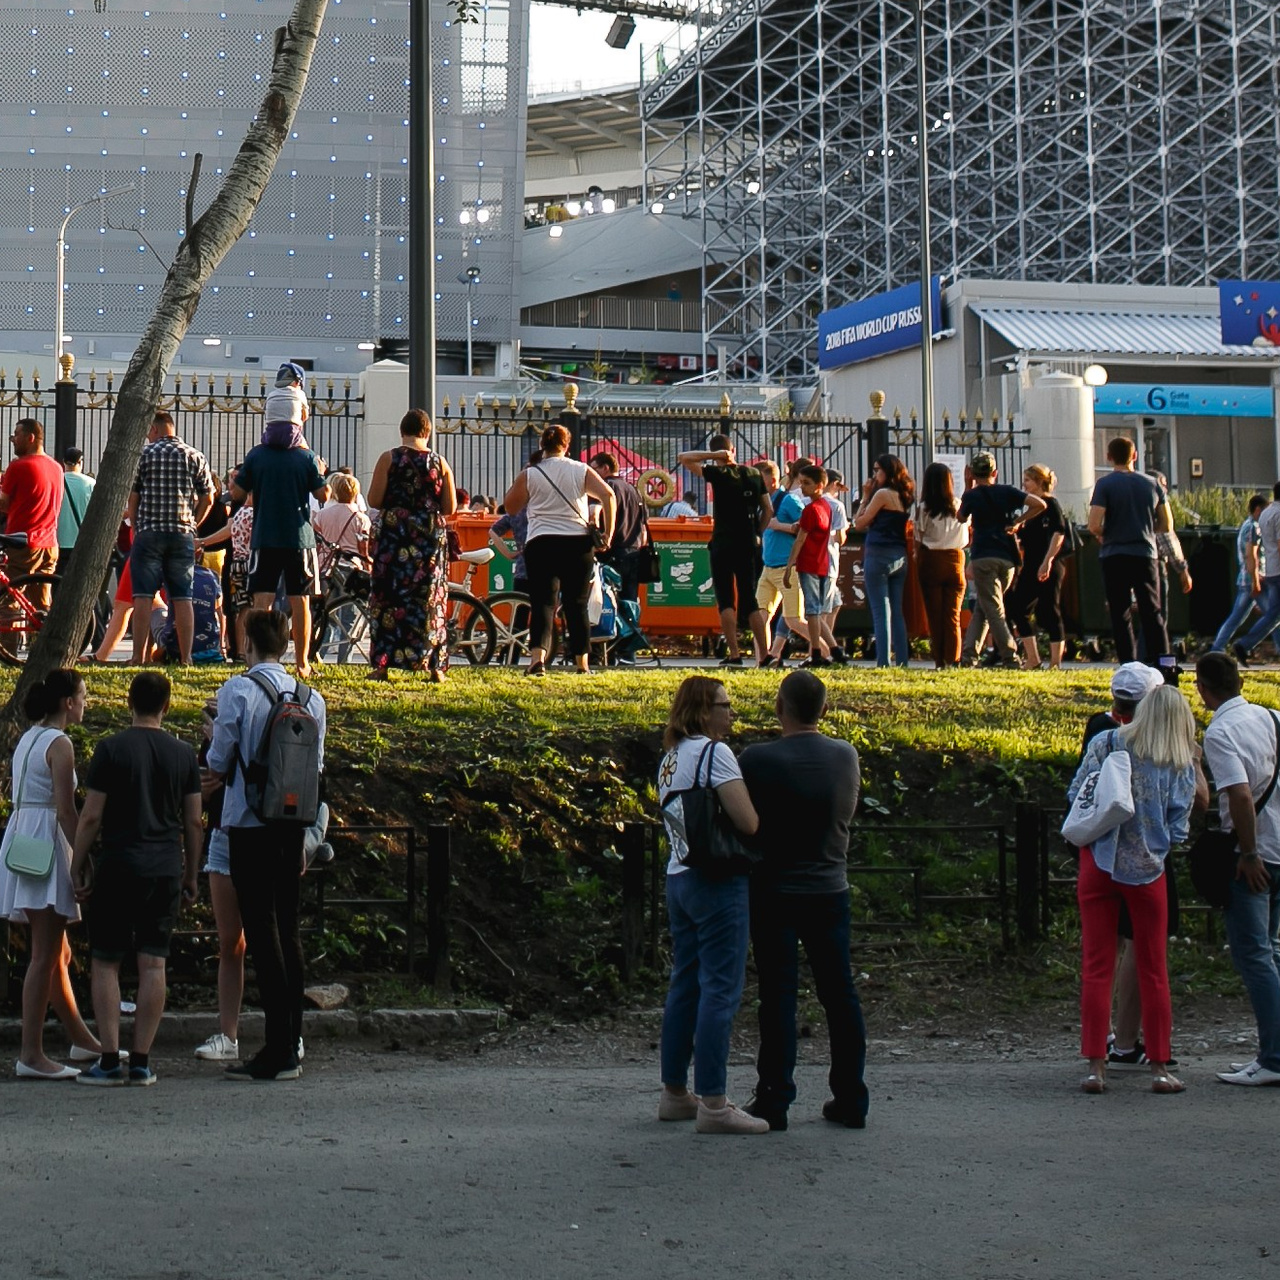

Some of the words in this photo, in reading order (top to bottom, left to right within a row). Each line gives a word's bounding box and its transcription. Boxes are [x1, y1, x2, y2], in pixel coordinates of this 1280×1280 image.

[825, 331, 842, 351] 2018
[841, 326, 857, 345] FIFA
[856, 318, 882, 340] WORLD
[883, 313, 898, 333] CUP
[898, 305, 923, 329] RUSSI
[1147, 387, 1167, 411] 6
[1170, 391, 1190, 400] Gate
